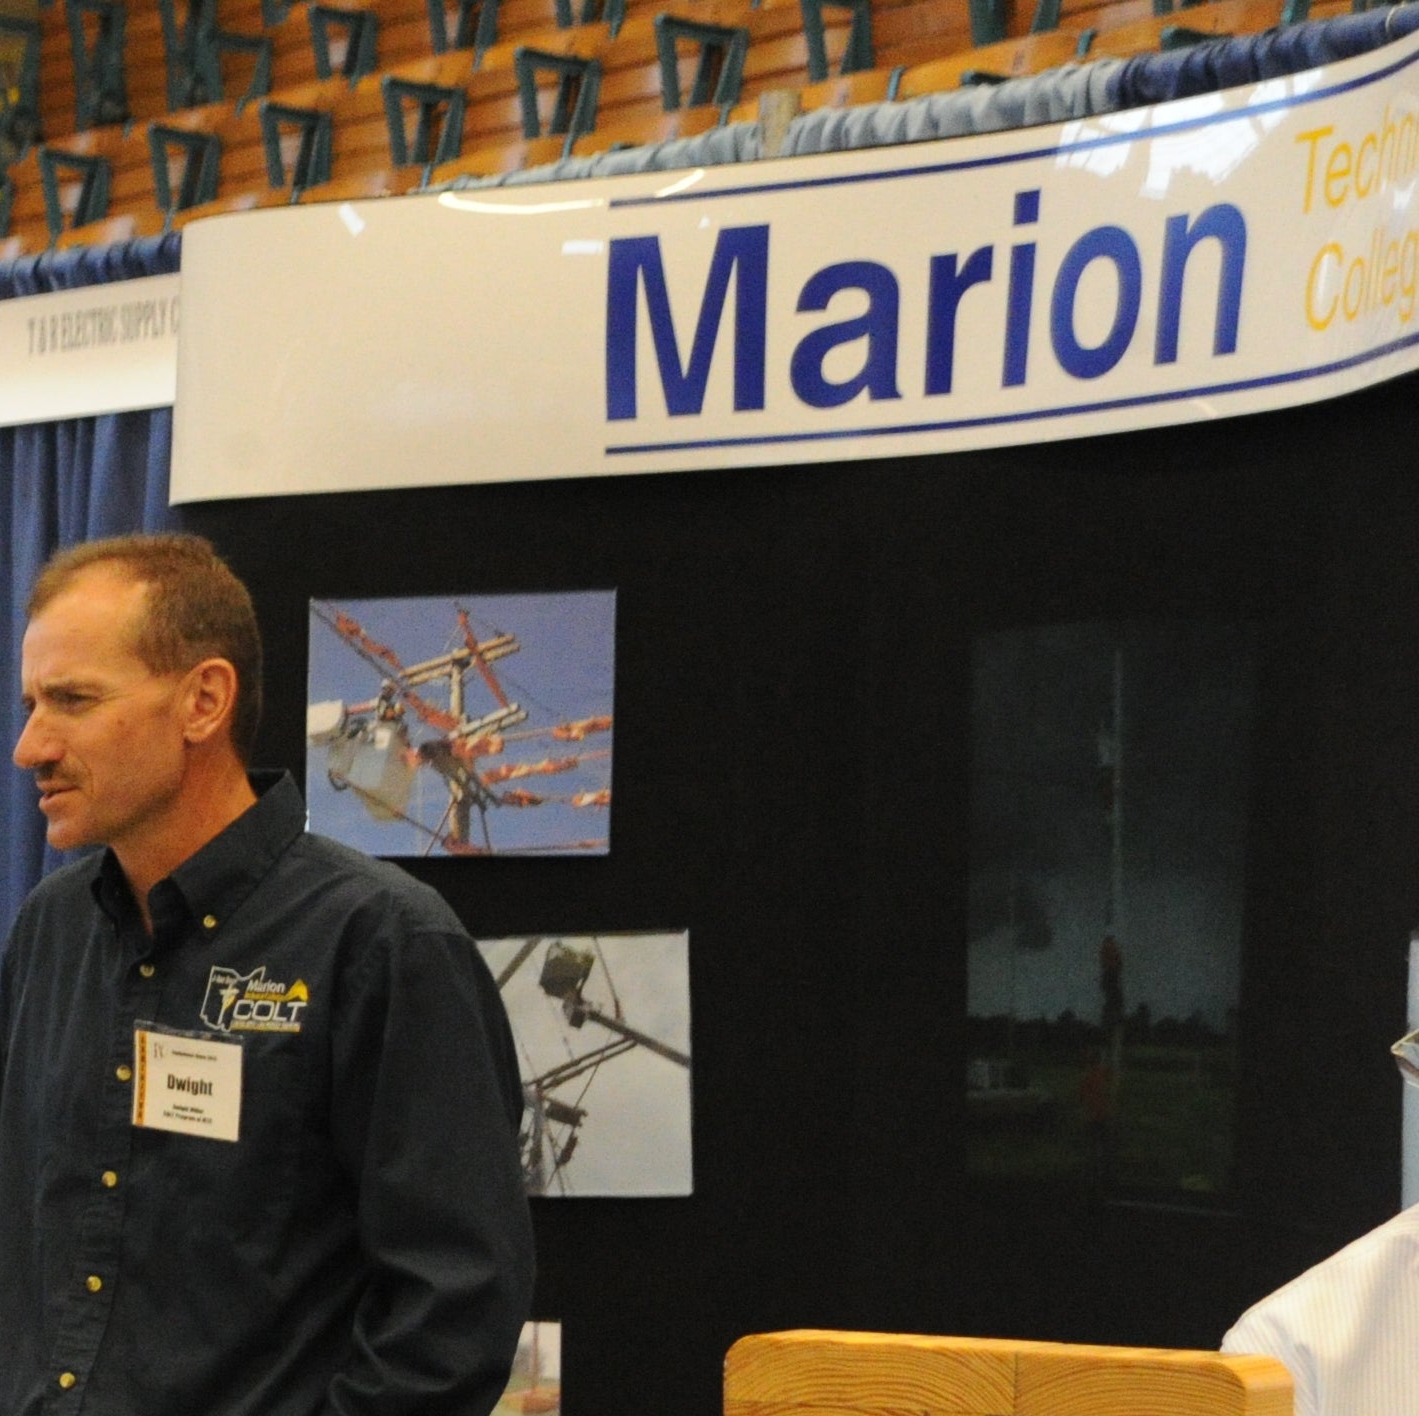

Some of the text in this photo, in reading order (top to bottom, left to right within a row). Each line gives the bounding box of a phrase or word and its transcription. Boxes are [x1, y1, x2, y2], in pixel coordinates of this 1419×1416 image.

[605, 188, 1249, 408] Marion
[61, 304, 117, 352] ELECTRIC
[120, 297, 167, 343] SUPPLY
[232, 1000, 308, 1022] COLT
[167, 1072, 213, 1097] Dwight
